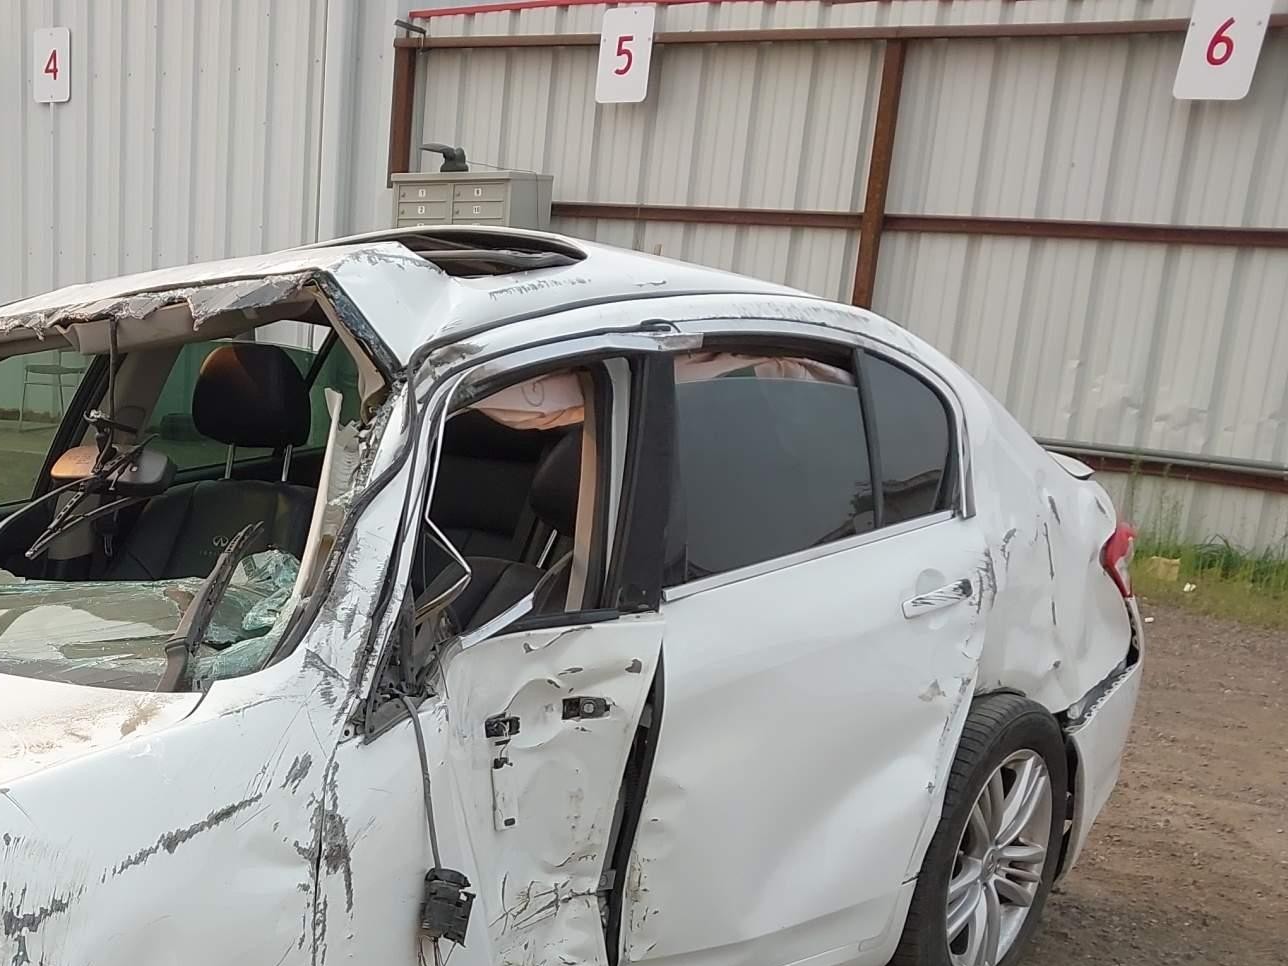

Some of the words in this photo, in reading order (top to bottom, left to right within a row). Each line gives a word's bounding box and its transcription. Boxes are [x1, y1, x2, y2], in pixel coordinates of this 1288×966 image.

[614, 35, 634, 76] 5
[1206, 16, 1236, 66] 6
[44, 49, 59, 81] 4
